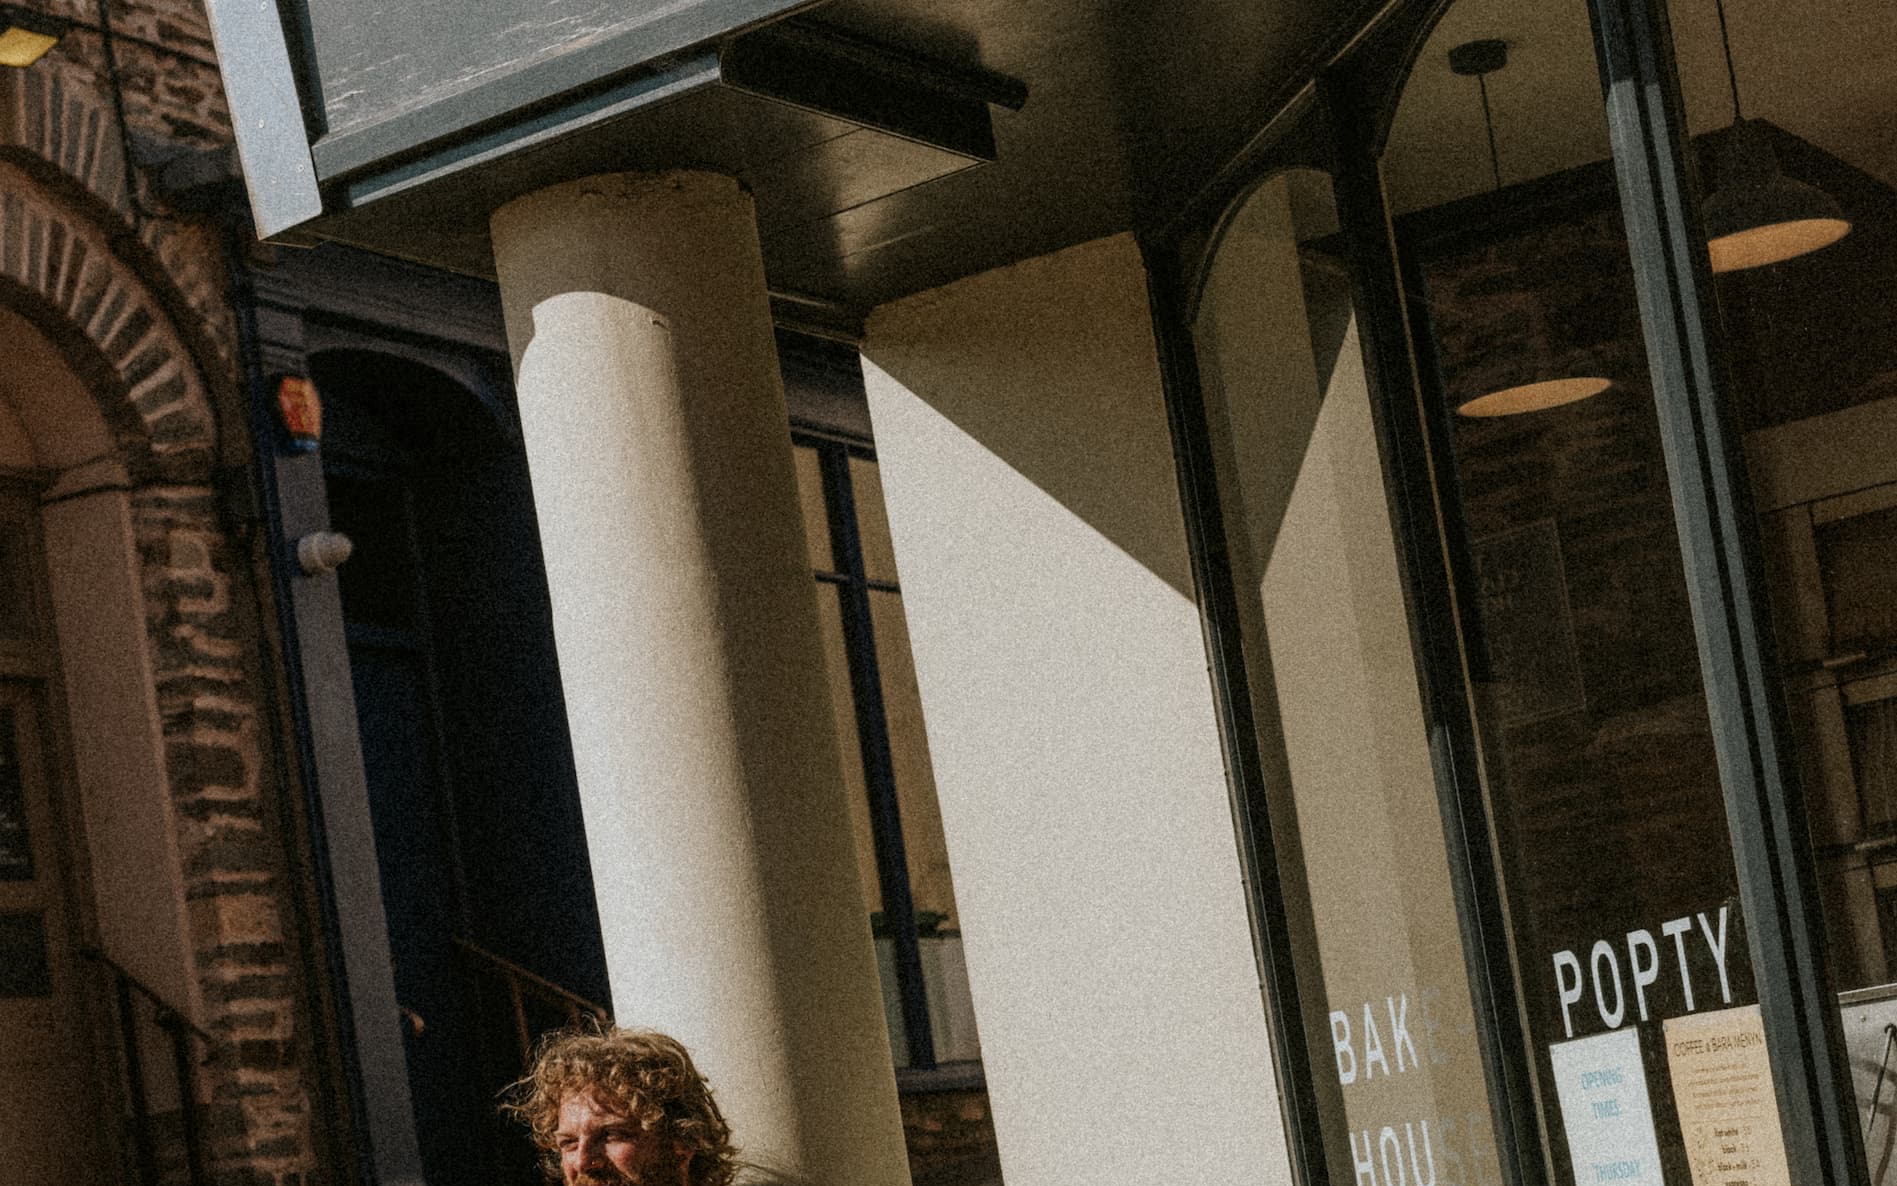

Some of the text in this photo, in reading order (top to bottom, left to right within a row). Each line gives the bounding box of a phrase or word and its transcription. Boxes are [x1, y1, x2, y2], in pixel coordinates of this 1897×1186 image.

[1553, 907, 1731, 1038] POPTY
[1674, 1039, 1704, 1057] COFFEE
[1592, 1159, 1640, 1182] THURSDAY
